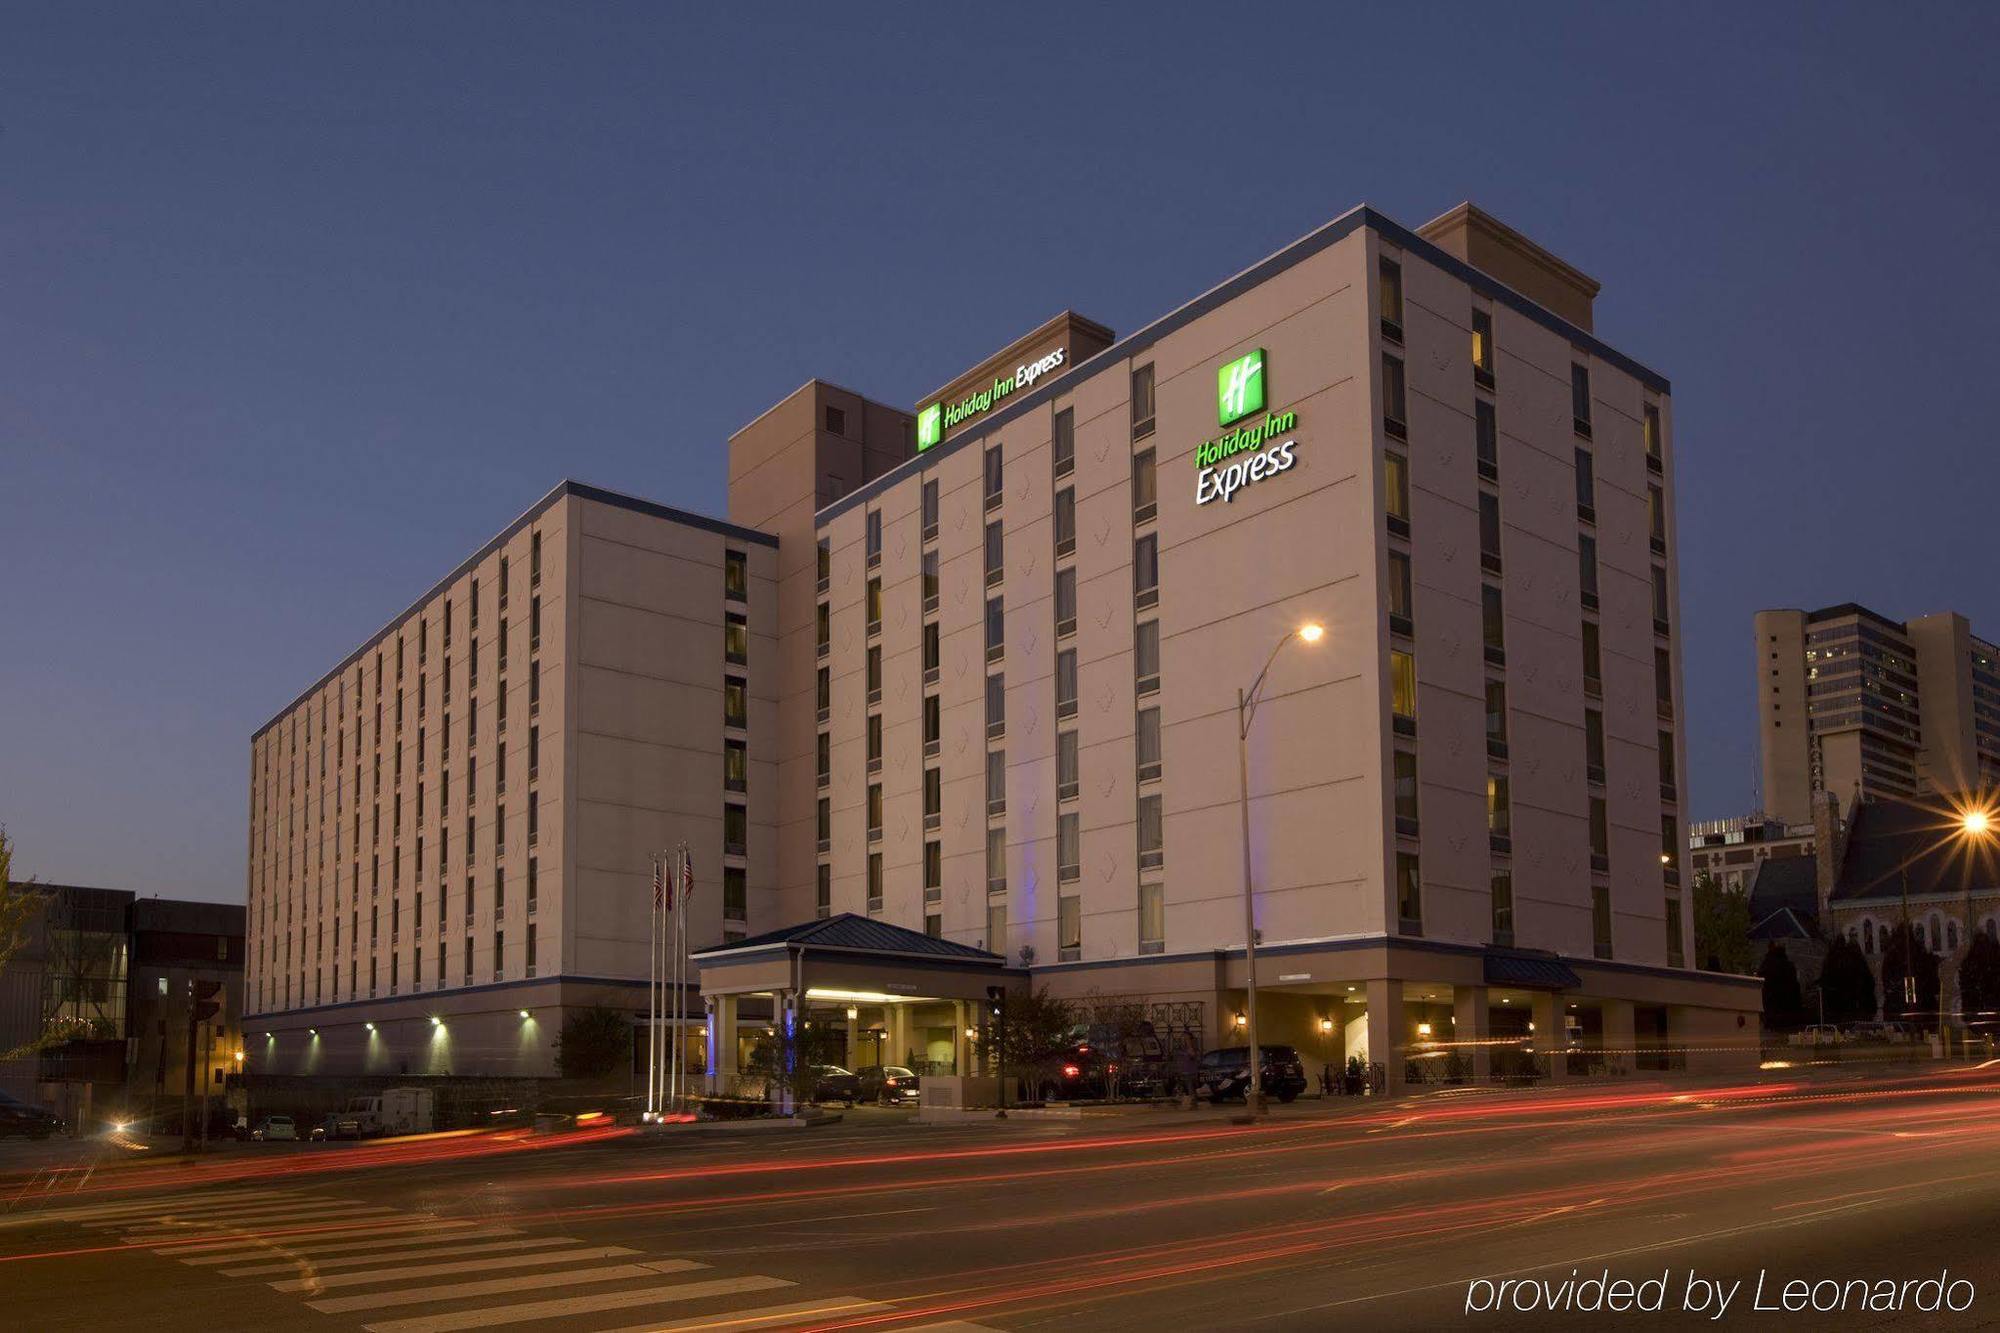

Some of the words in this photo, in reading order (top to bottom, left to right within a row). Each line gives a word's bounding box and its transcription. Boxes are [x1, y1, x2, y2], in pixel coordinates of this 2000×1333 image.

[944, 389, 993, 429] Holiday
[993, 376, 1015, 401] Inn
[1015, 347, 1064, 389] Express
[1194, 425, 1263, 469] Holiday
[1263, 411, 1295, 439] Inn
[1196, 440, 1295, 505] Express
